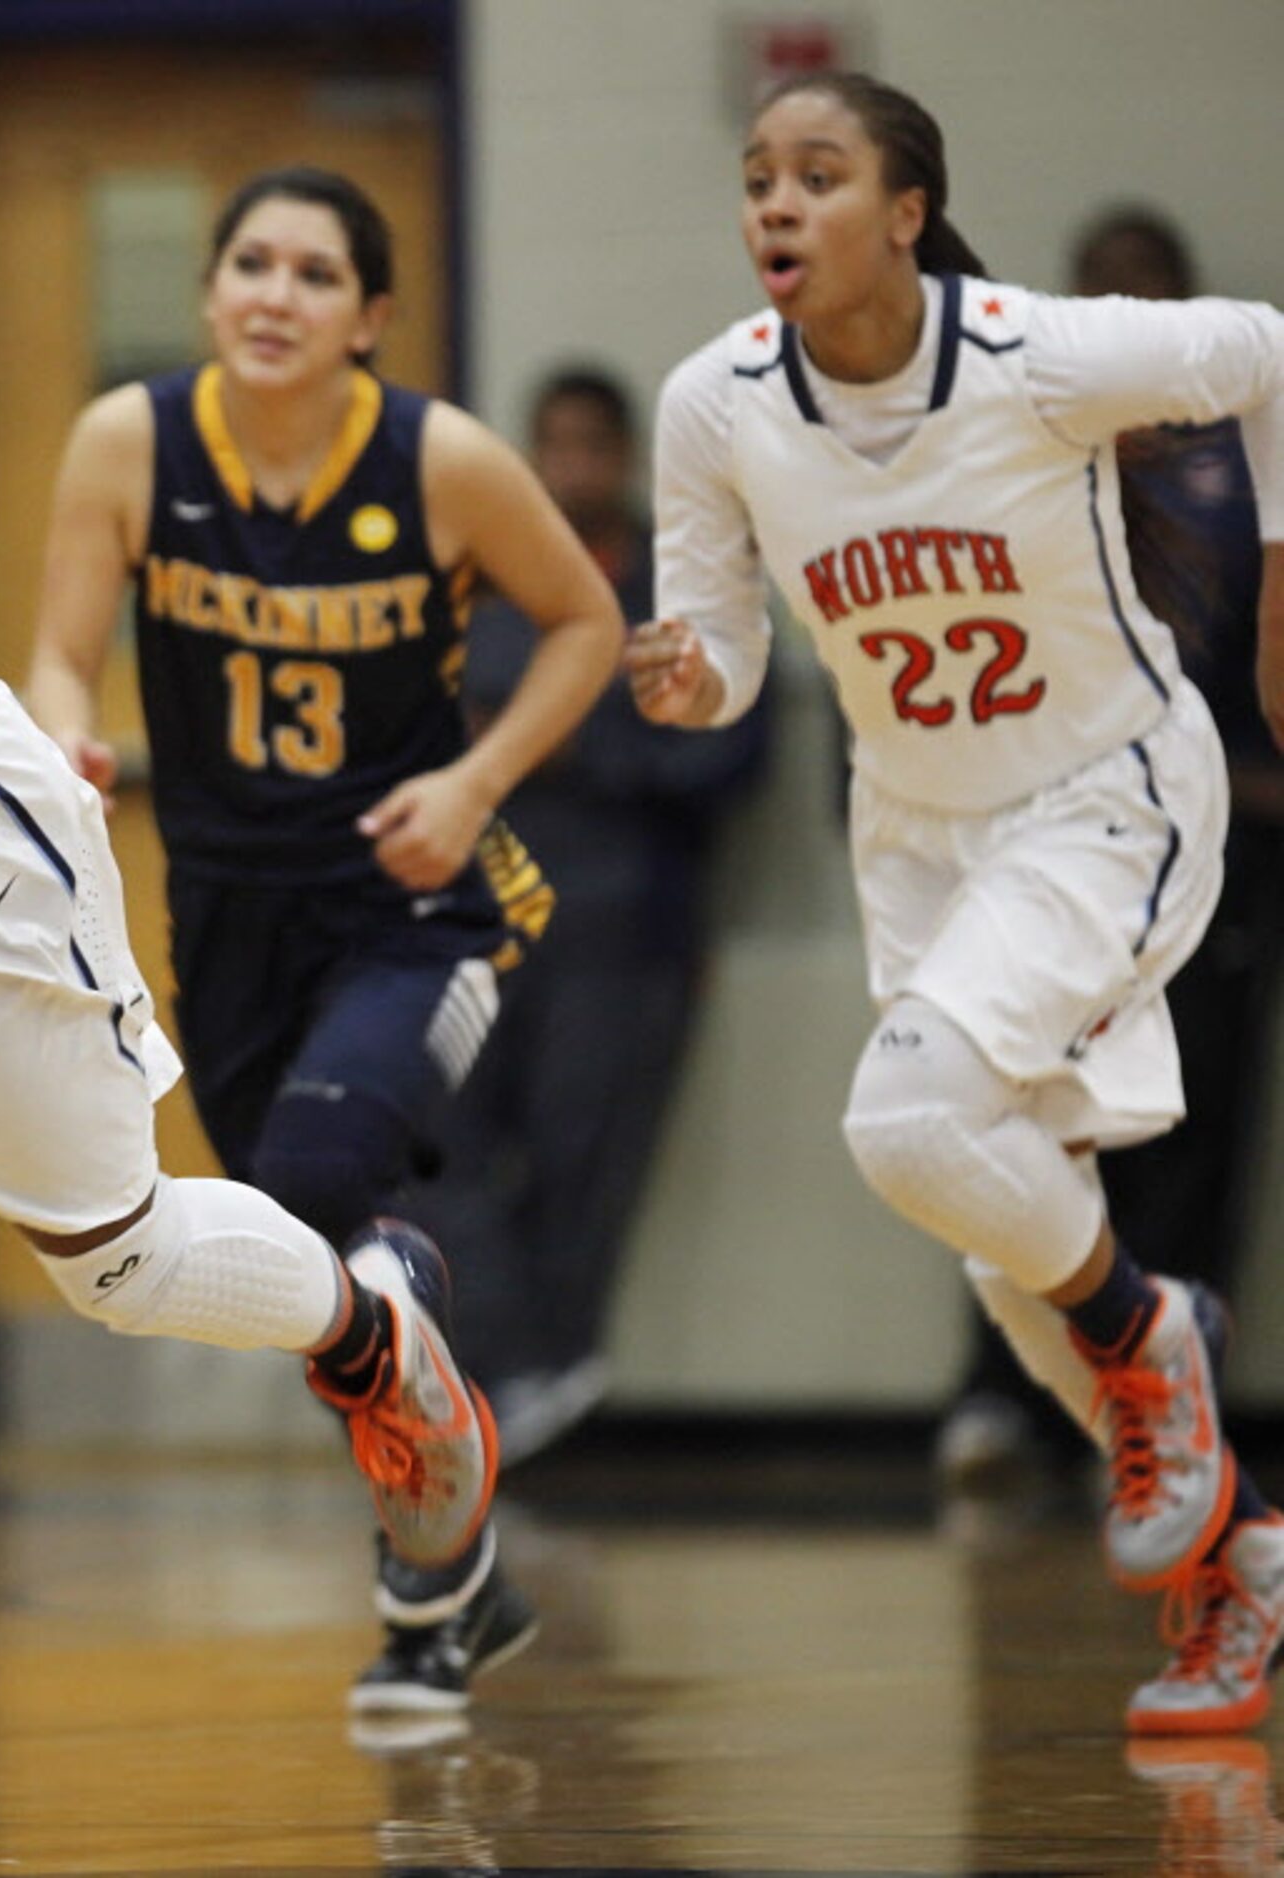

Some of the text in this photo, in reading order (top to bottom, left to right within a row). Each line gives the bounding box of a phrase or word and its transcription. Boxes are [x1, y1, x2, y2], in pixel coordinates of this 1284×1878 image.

[146, 554, 431, 654] MCKINNEY
[803, 526, 1023, 624] NORTH
[224, 651, 345, 778] 13
[858, 618, 1046, 728] 22
